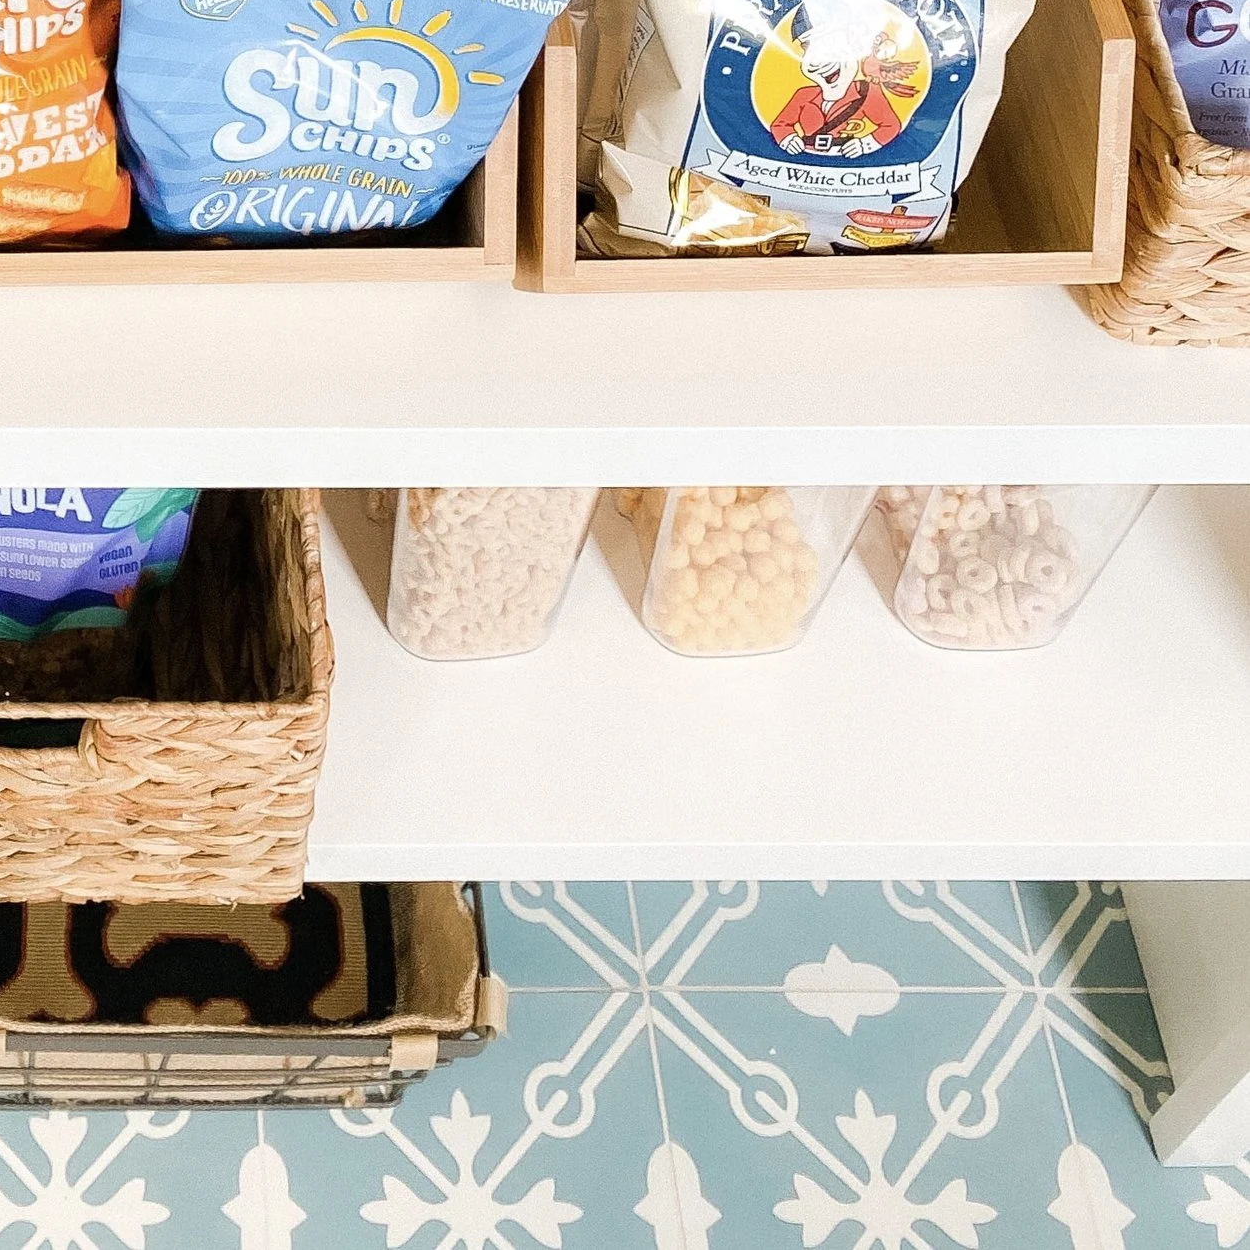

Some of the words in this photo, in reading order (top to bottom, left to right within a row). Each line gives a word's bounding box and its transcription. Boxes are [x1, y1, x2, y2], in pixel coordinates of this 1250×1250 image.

[29, 54, 90, 98] GRAIN
[211, 48, 452, 163] Sun
[290, 121, 437, 171] CHIPS
[277, 162, 345, 185] WHOLE
[348, 168, 415, 199] GRAIN
[734, 157, 781, 178] Aged
[786, 166, 835, 187] White
[840, 169, 912, 187] Cheddar
